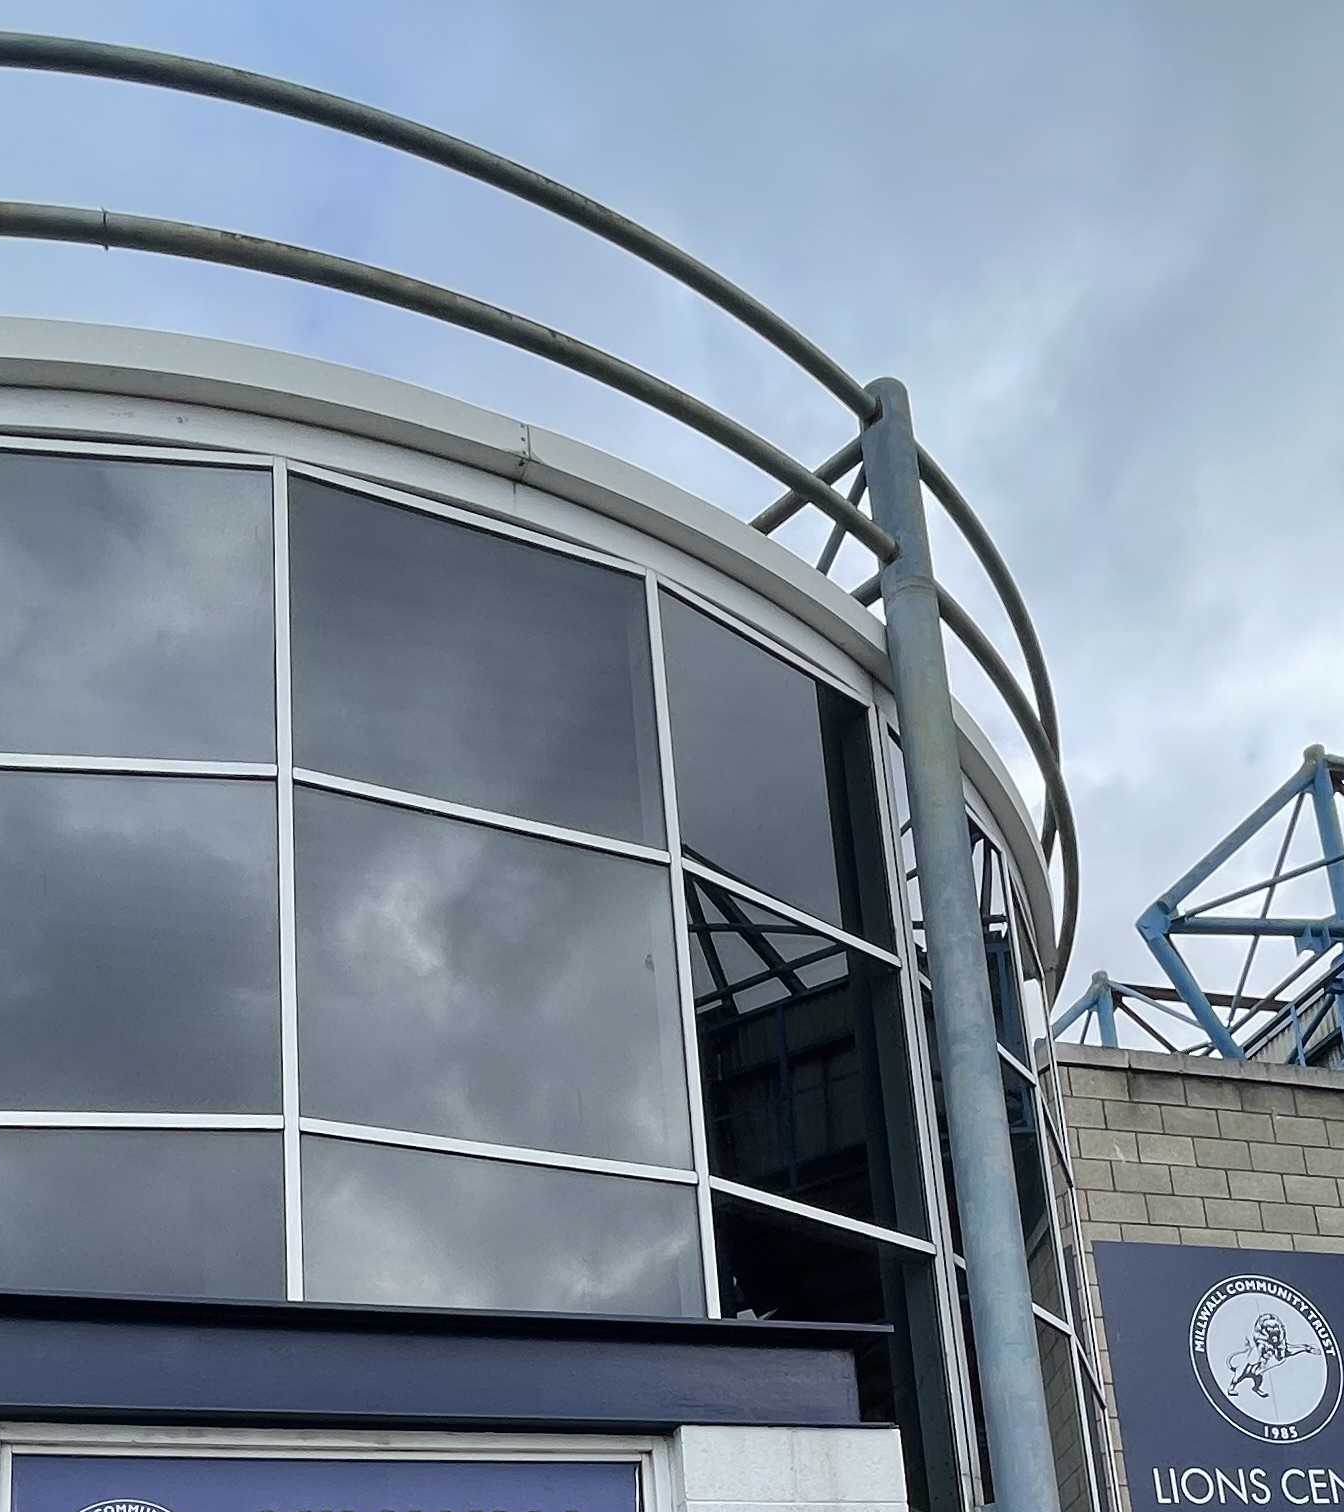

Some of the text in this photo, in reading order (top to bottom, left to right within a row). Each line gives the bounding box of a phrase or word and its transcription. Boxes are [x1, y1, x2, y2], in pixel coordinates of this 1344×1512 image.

[1194, 1280, 1337, 1357] MILLWALL COMMUNITY TRUST
[1264, 1425, 1298, 1440] 1985
[1152, 1467, 1272, 1505] LIONS
